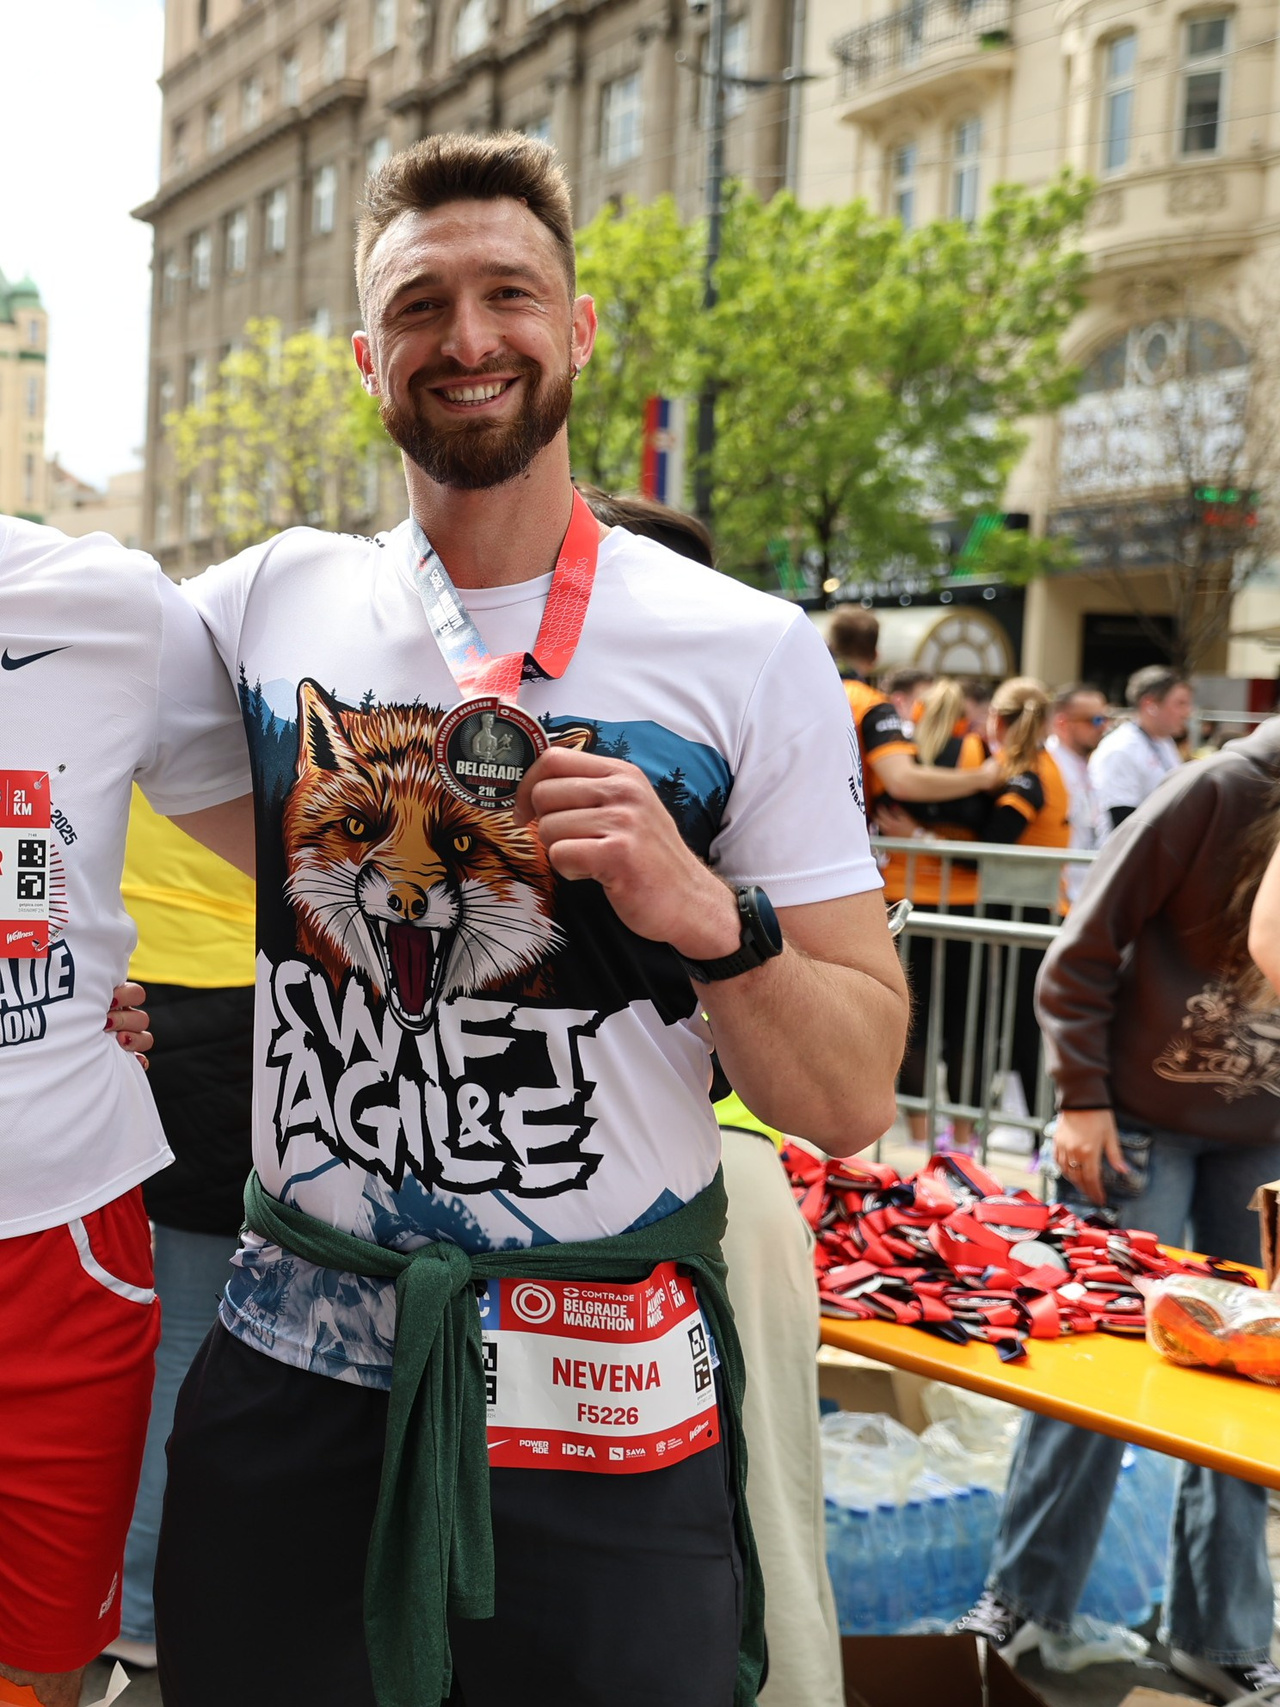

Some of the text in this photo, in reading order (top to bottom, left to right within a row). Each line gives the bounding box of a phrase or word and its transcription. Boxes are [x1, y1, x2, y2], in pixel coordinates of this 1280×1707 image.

[456, 760, 524, 782] BELGRADE
[13, 790, 26, 802] 21
[478, 786, 497, 797] 21K
[13, 803, 32, 816] KM
[51, 809, 78, 846] 2025
[6, 930, 34, 944] Wellness
[272, 959, 599, 1090] SWIFT
[669, 1279, 678, 1294] 21
[581, 1290, 635, 1302] COMTRADE
[673, 1290, 686, 1308] KM
[563, 1298, 627, 1318] BELGRADE
[563, 1311, 635, 1331] MARATHON
[646, 1306, 664, 1329] MORE
[552, 1357, 661, 1393] NEVENA
[577, 1402, 639, 1426] F5226
[519, 1439, 549, 1449] POWER
[625, 1447, 646, 1456] SAVA
